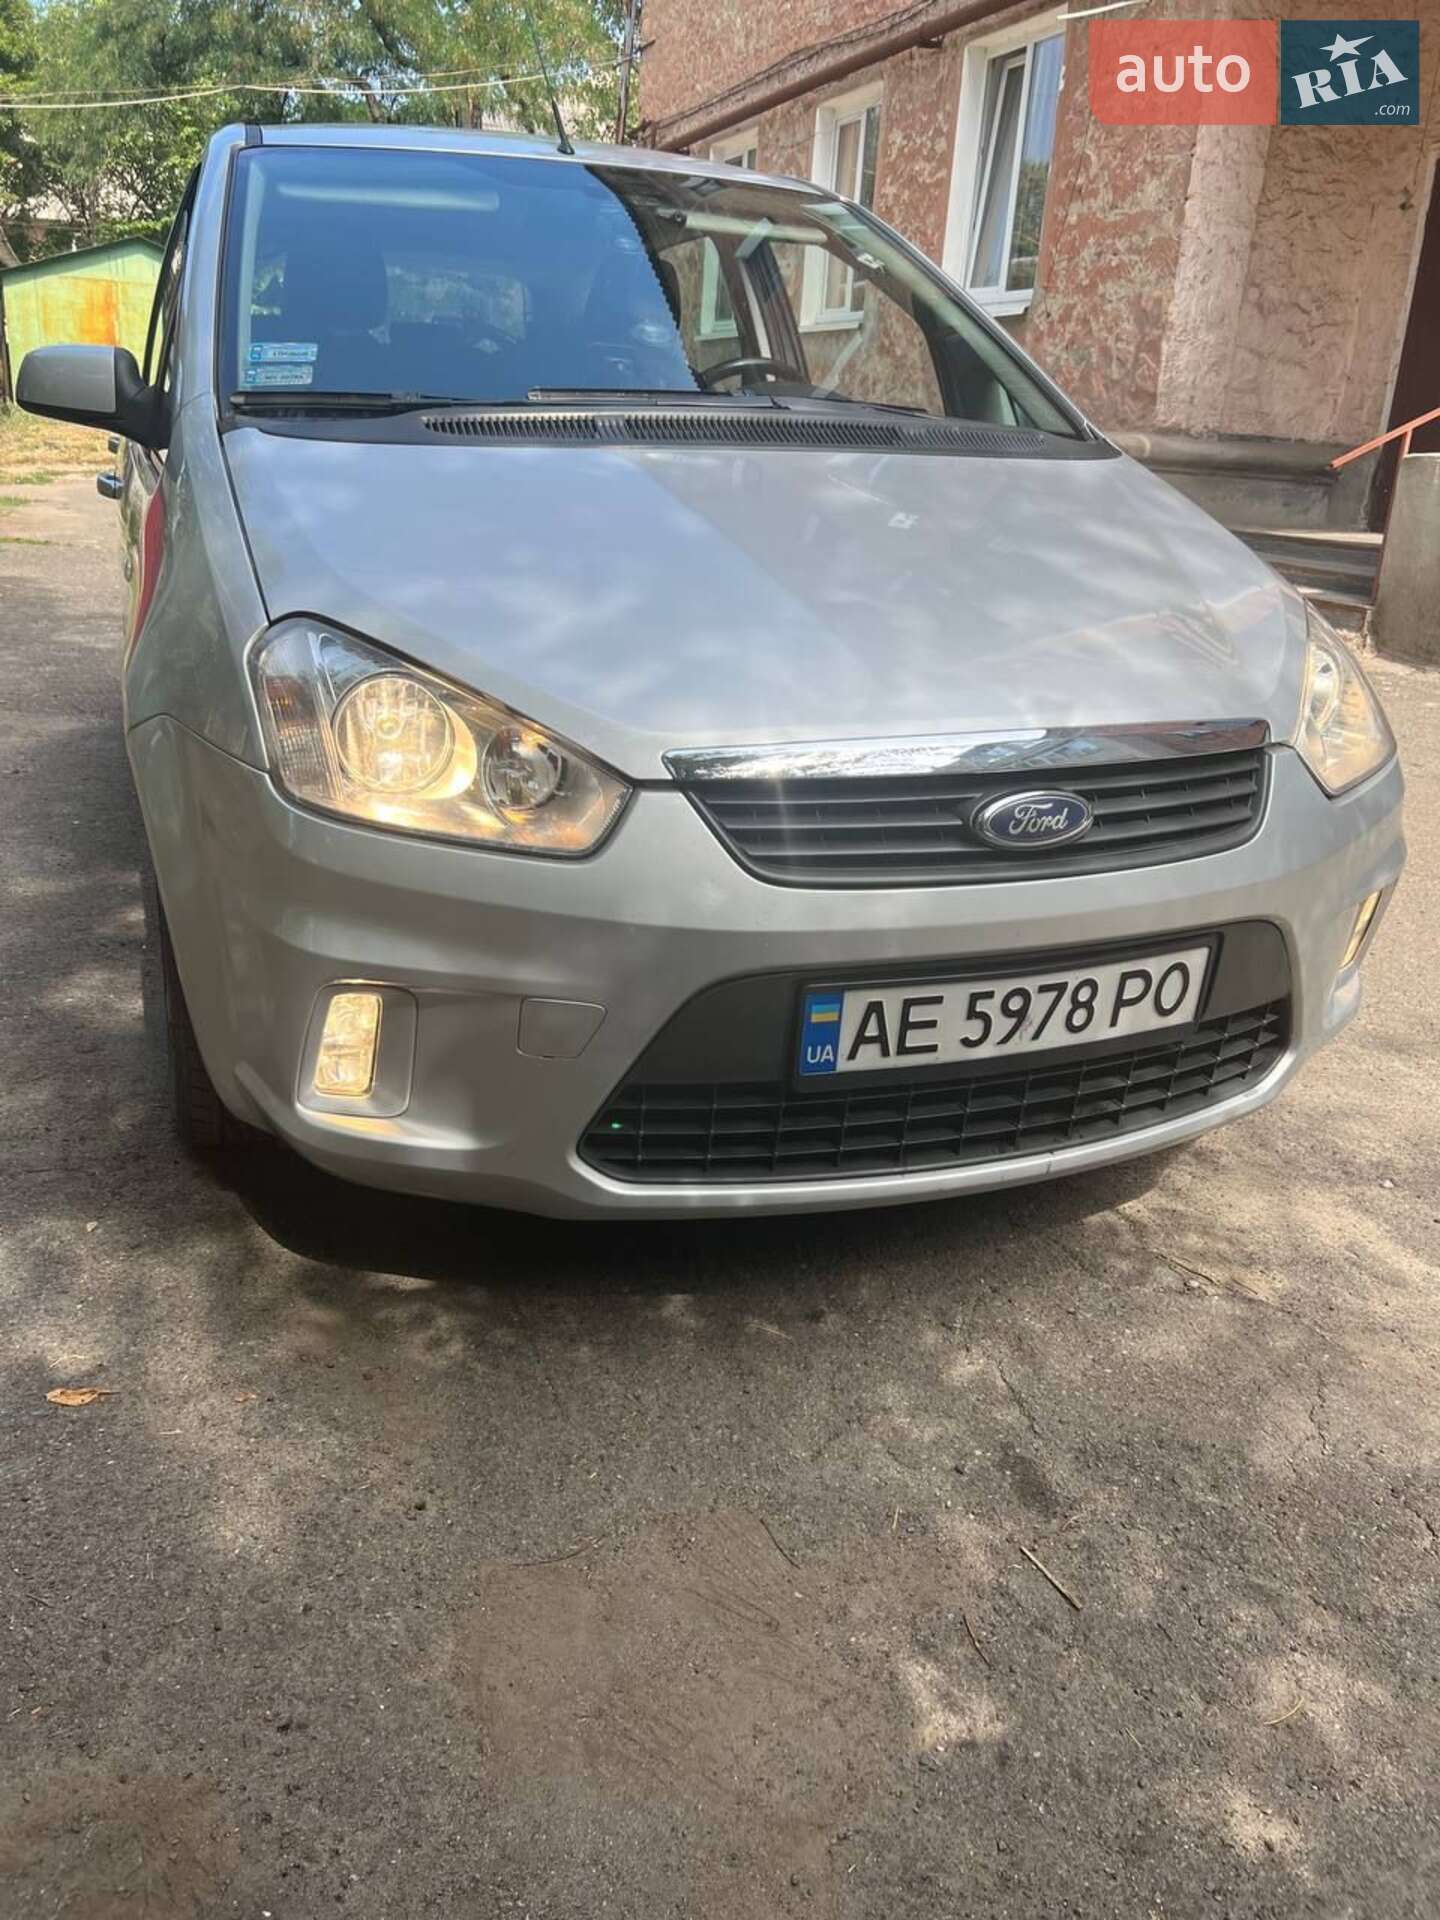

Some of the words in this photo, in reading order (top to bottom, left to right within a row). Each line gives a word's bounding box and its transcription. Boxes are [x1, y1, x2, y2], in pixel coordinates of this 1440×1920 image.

[1008, 802, 1068, 835] Ford
[847, 995, 944, 1061] AE
[959, 977, 1099, 1049] 5978
[1109, 960, 1190, 1028] PO
[807, 1044, 834, 1065] UA
